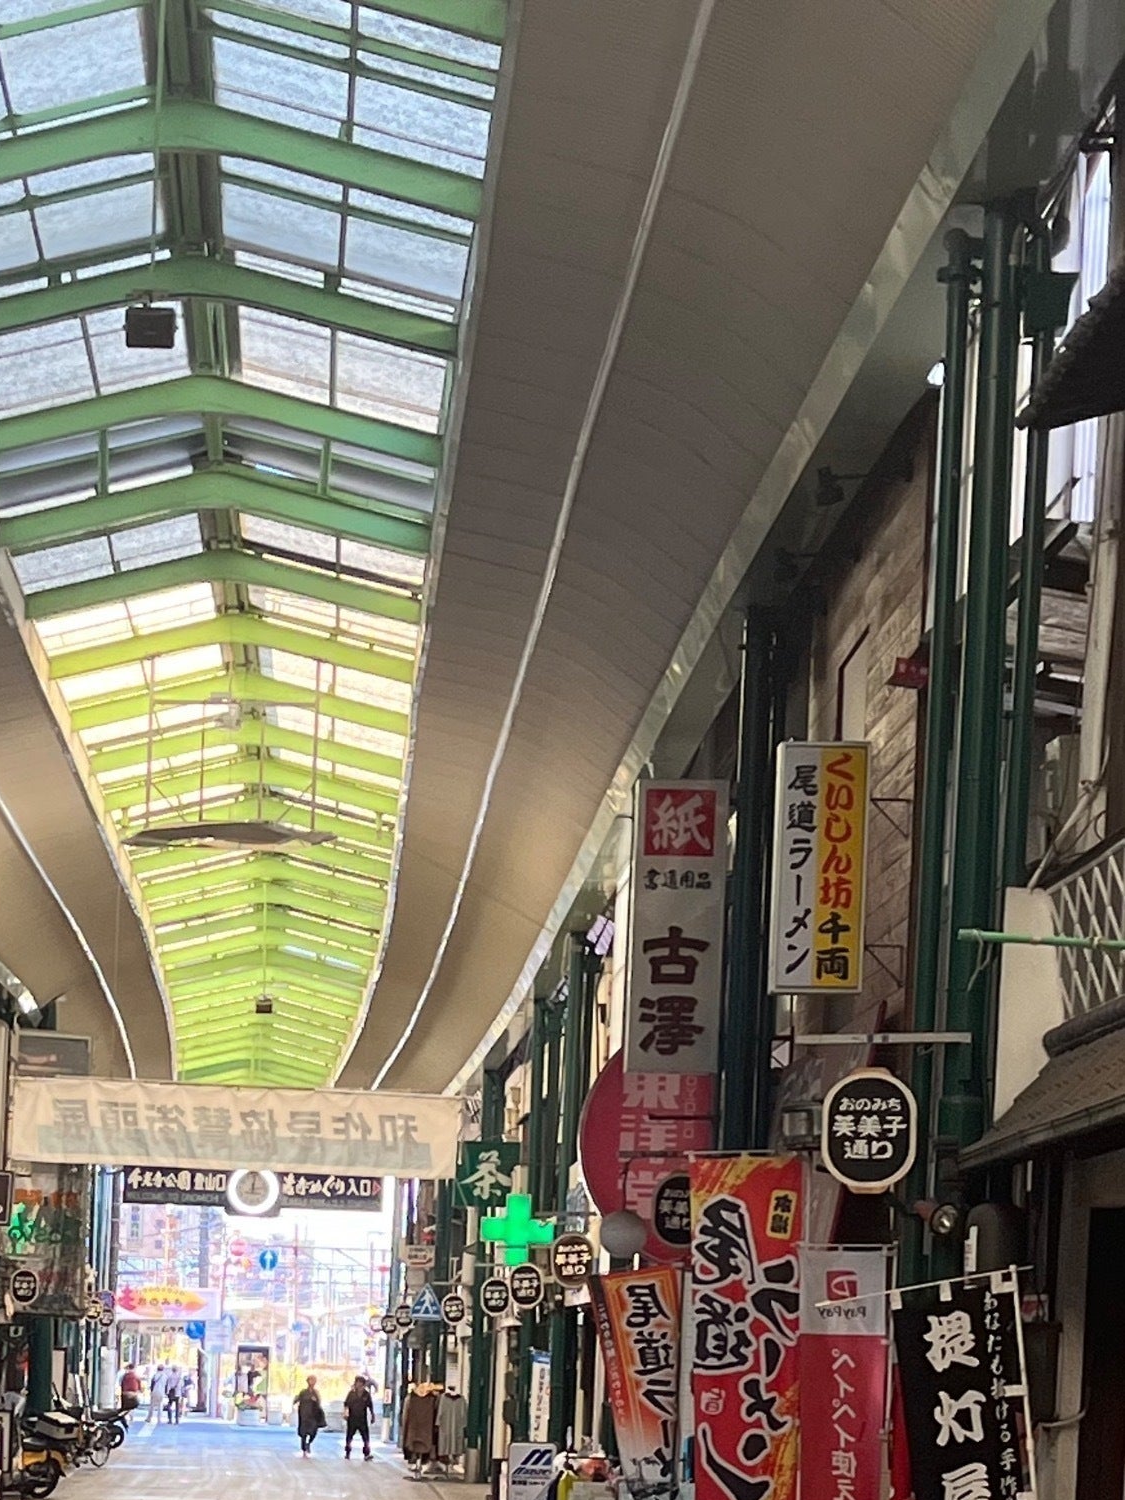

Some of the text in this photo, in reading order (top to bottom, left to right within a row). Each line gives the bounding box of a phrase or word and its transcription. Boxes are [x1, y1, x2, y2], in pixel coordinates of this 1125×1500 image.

[651, 793, 711, 851] 紙
[643, 867, 712, 891] 書道用品
[783, 763, 820, 976] 尾道ラーメン
[813, 751, 857, 982] くいしん坊千両
[638, 925, 711, 1056] 古澤
[832, 1114, 908, 1139] 芙美子
[839, 1096, 902, 1113] おのみち
[459, 1150, 512, 1200] 茶
[843, 1139, 895, 1162] 通り
